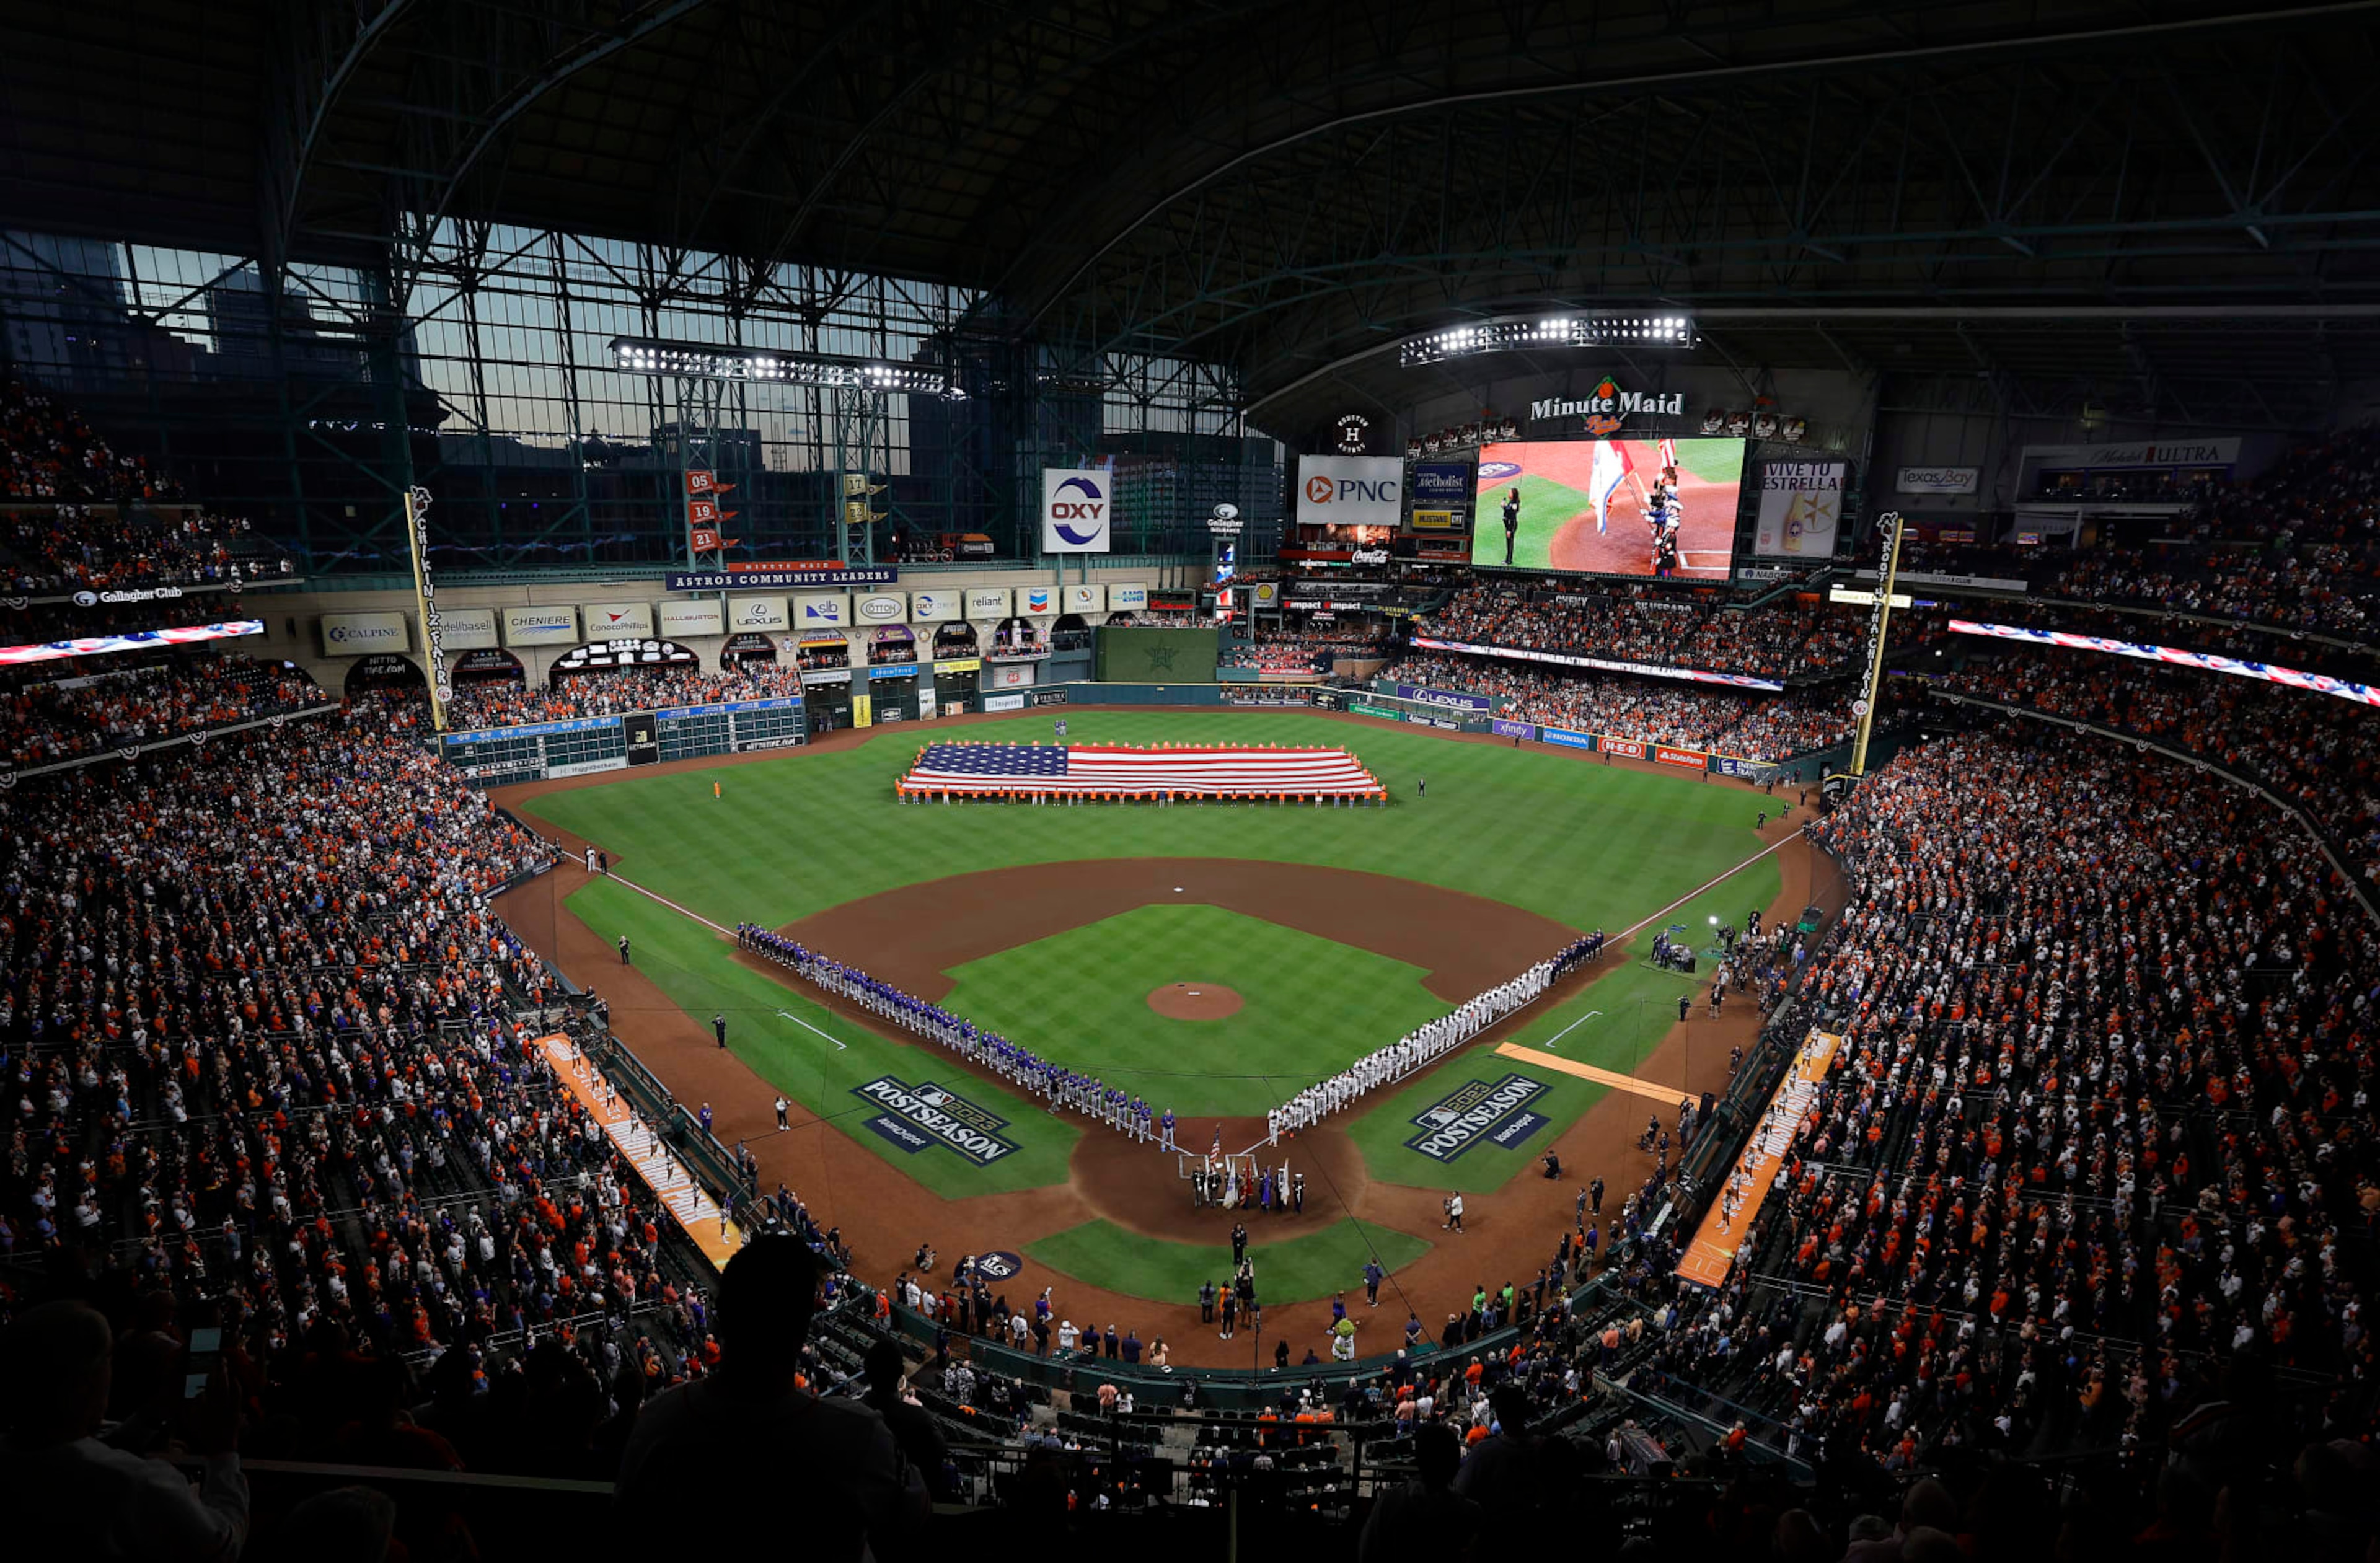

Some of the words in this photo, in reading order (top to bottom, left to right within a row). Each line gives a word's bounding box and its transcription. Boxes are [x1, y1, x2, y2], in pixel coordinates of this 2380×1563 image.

[1530, 395, 1613, 421] Minute
[1618, 392, 1684, 415] Maid
[1337, 414, 1369, 428] HOUSTON
[1344, 427, 1360, 442] H
[2158, 446, 2219, 462] ULTRA
[1809, 463, 1830, 476] TU
[692, 475, 708, 488] 05
[1417, 475, 1463, 488] Methodist
[1336, 480, 1396, 501] PNC
[695, 505, 711, 517] 19
[1051, 503, 1104, 519] OXY
[696, 533, 712, 545] 21
[676, 575, 733, 587] ASTROS
[739, 572, 827, 584] COMMUNITY
[832, 570, 889, 583] LEADERS
[1756, 570, 1789, 579] NABOR
[99, 589, 154, 604] Gallagher
[154, 586, 183, 599] Club
[1875, 586, 1884, 597] 4
[416, 517, 434, 597] CHIKIN
[429, 629, 447, 685] FAIR
[818, 600, 838, 613] slb
[972, 596, 1002, 607] reliant
[1290, 601, 1322, 611] impact
[1331, 601, 1360, 612] impact
[511, 615, 570, 626] CHENIERE
[591, 622, 648, 632] ConocoPhillips
[736, 616, 782, 625] LEXUS
[348, 627, 399, 638] CALPINE
[369, 656, 399, 666] NITTO
[1541, 653, 1565, 663] HAILED
[1576, 658, 1589, 666] THE
[1591, 659, 1631, 671] TWILIGHT'S
[1633, 664, 1652, 674] LAST
[363, 664, 406, 676] TIRE.COM
[995, 698, 1021, 708] Insperity
[1429, 693, 1474, 708] LEXUS
[1500, 723, 1528, 737] xfinity
[1553, 732, 1587, 744] HONDA
[1448, 1085, 1491, 1112] 2023
[863, 1080, 1008, 1160] POSTSEASON
[943, 1101, 998, 1131] 2023
[1418, 1078, 1540, 1157] POSTSEASON
[1493, 1114, 1535, 1143] loanDepot
[979, 1257, 1011, 1276] ALCS
